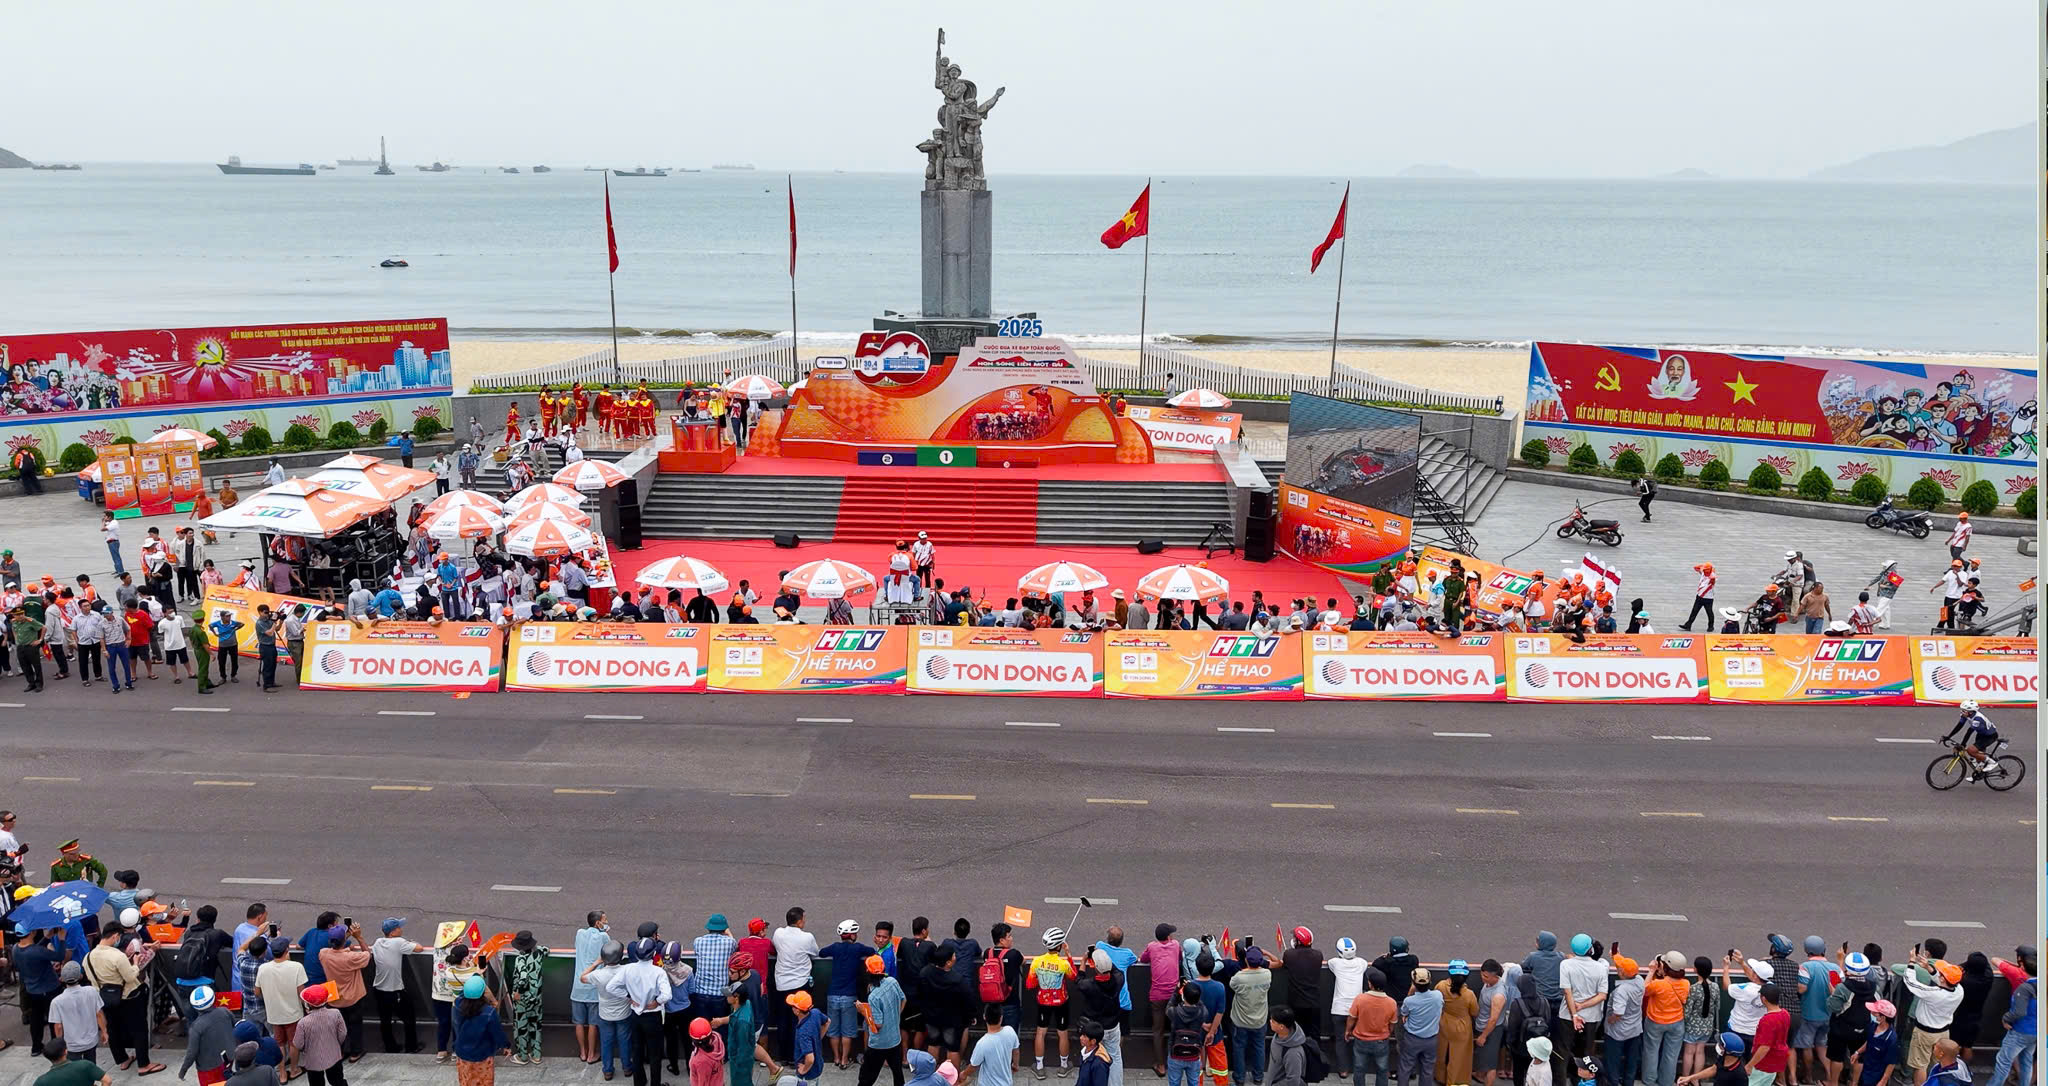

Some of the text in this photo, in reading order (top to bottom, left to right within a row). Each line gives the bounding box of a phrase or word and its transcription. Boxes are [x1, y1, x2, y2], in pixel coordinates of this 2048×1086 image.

[998, 320, 1042, 337] 2025
[1576, 402, 1587, 419] TẤT
[1587, 402, 1596, 420] CẢ
[1596, 405, 1604, 420] VÌ
[1604, 409, 1618, 424] MỤC
[1620, 408, 1632, 423] TIÊU
[1633, 409, 1647, 424] DÂN
[1648, 410, 1663, 426] GIÀU,
[1665, 410, 1682, 427] NƯỚC
[1683, 415, 1704, 431] MẠNH,
[1706, 414, 1720, 430] DÂN
[1720, 413, 1735, 432] CHỦ,
[1737, 416, 1755, 432] CÔNG
[1756, 414, 1776, 435] BẰNG,
[1778, 420, 1792, 435] VĂN
[1792, 423, 1811, 437] MINH
[1147, 430, 1224, 444] TON DONG A
[944, 452, 949, 461] 1
[462, 626, 491, 637] HTV
[667, 628, 698, 637] HTV
[1062, 633, 1092, 643] HTV
[816, 631, 885, 649] HTV
[1211, 638, 1279, 656] HTV
[1462, 636, 1492, 646] HTV
[1662, 639, 1693, 648] HTV
[1816, 642, 1886, 660] HTV
[349, 658, 482, 676] TON DONG A
[555, 660, 690, 677] TON DONG A
[835, 658, 876, 671] THAO
[1230, 664, 1272, 677] THAO
[953, 664, 1087, 682] TON DONG A
[1350, 668, 1488, 685] TON DONG A
[1553, 672, 1691, 688] TON DONG A
[1837, 668, 1880, 681] THAO
[1960, 674, 2008, 691] TON
